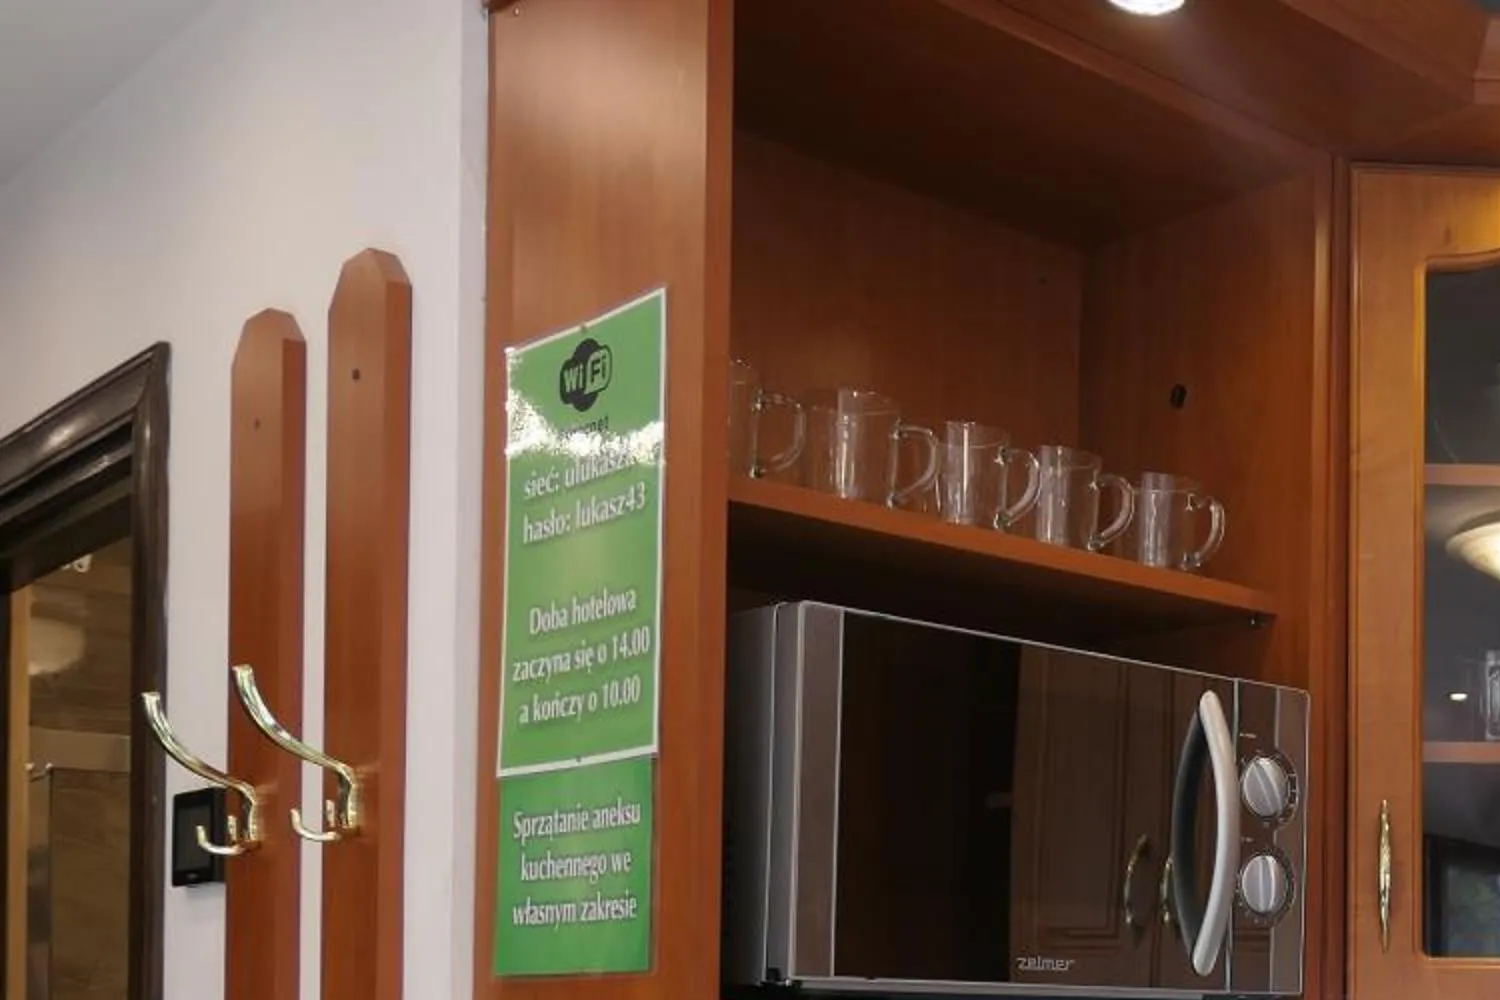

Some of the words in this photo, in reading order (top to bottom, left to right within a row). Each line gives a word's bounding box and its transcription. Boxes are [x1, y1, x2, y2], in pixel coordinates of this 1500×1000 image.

[523, 466, 559, 500] sieć:
[523, 505, 571, 544] hasło:
[576, 481, 646, 530] lukasz43
[529, 601, 568, 635] Doba
[571, 587, 637, 625] hotelowa
[512, 652, 571, 684] zaczyna
[573, 639, 595, 674] się
[597, 643, 608, 664] o
[612, 626, 650, 661] 14.00
[519, 704, 529, 724] a
[532, 691, 584, 722] kończy
[588, 691, 597, 712] o
[602, 673, 641, 709] 10.00
[513, 803, 589, 846] Sprzątanie
[592, 796, 641, 830] aneksu
[521, 850, 607, 884] kuchennego
[611, 851, 632, 873] we
[513, 896, 577, 932] własnym
[580, 889, 637, 922] zakresie
